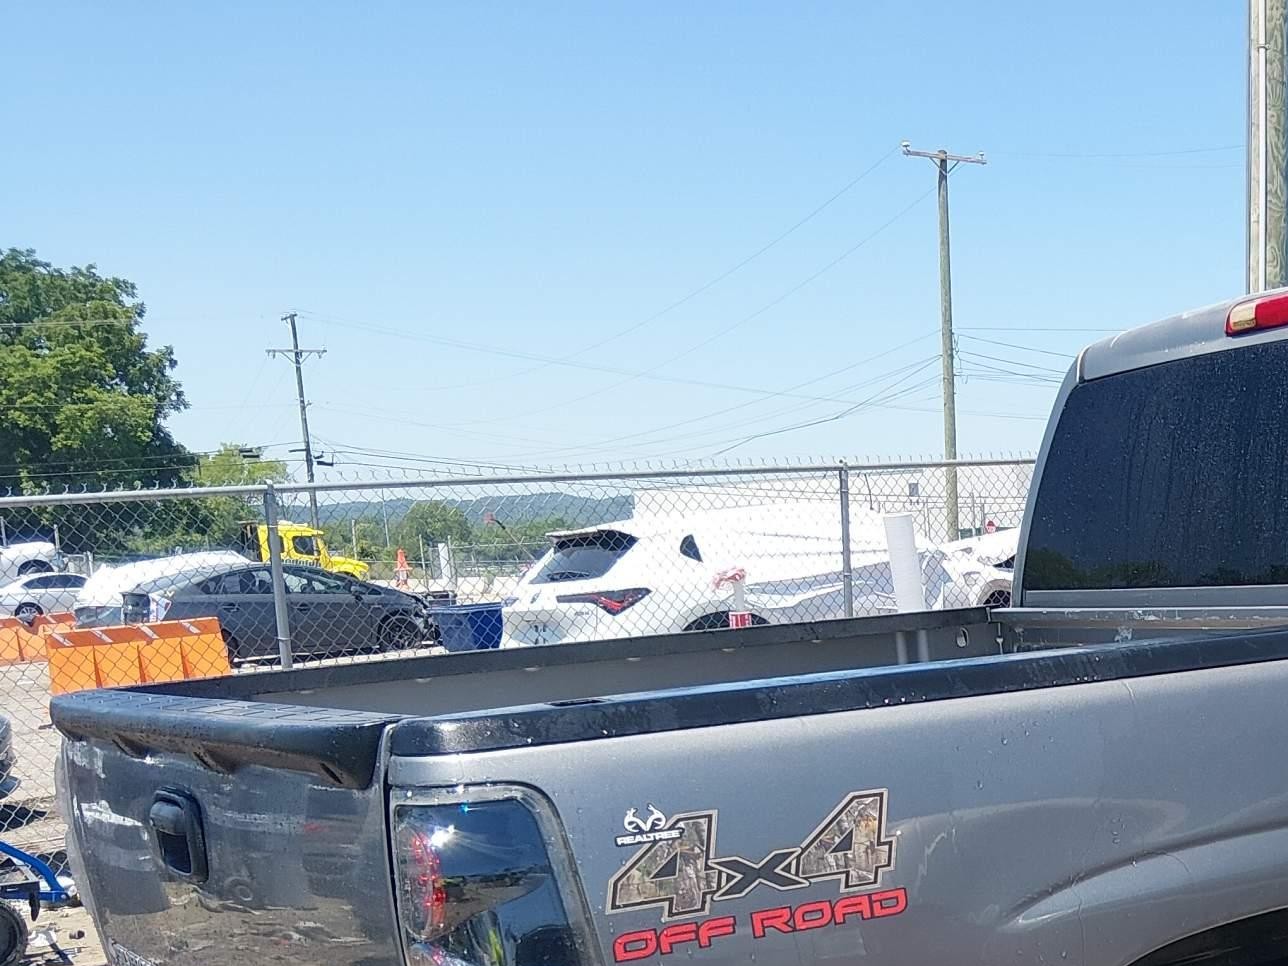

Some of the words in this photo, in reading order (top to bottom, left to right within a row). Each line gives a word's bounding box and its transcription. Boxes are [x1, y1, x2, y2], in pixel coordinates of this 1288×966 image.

[605, 787, 898, 922] 4x4
[616, 829, 682, 845] REALTREE
[612, 916, 737, 963] OFF
[750, 887, 908, 939] ROAD
